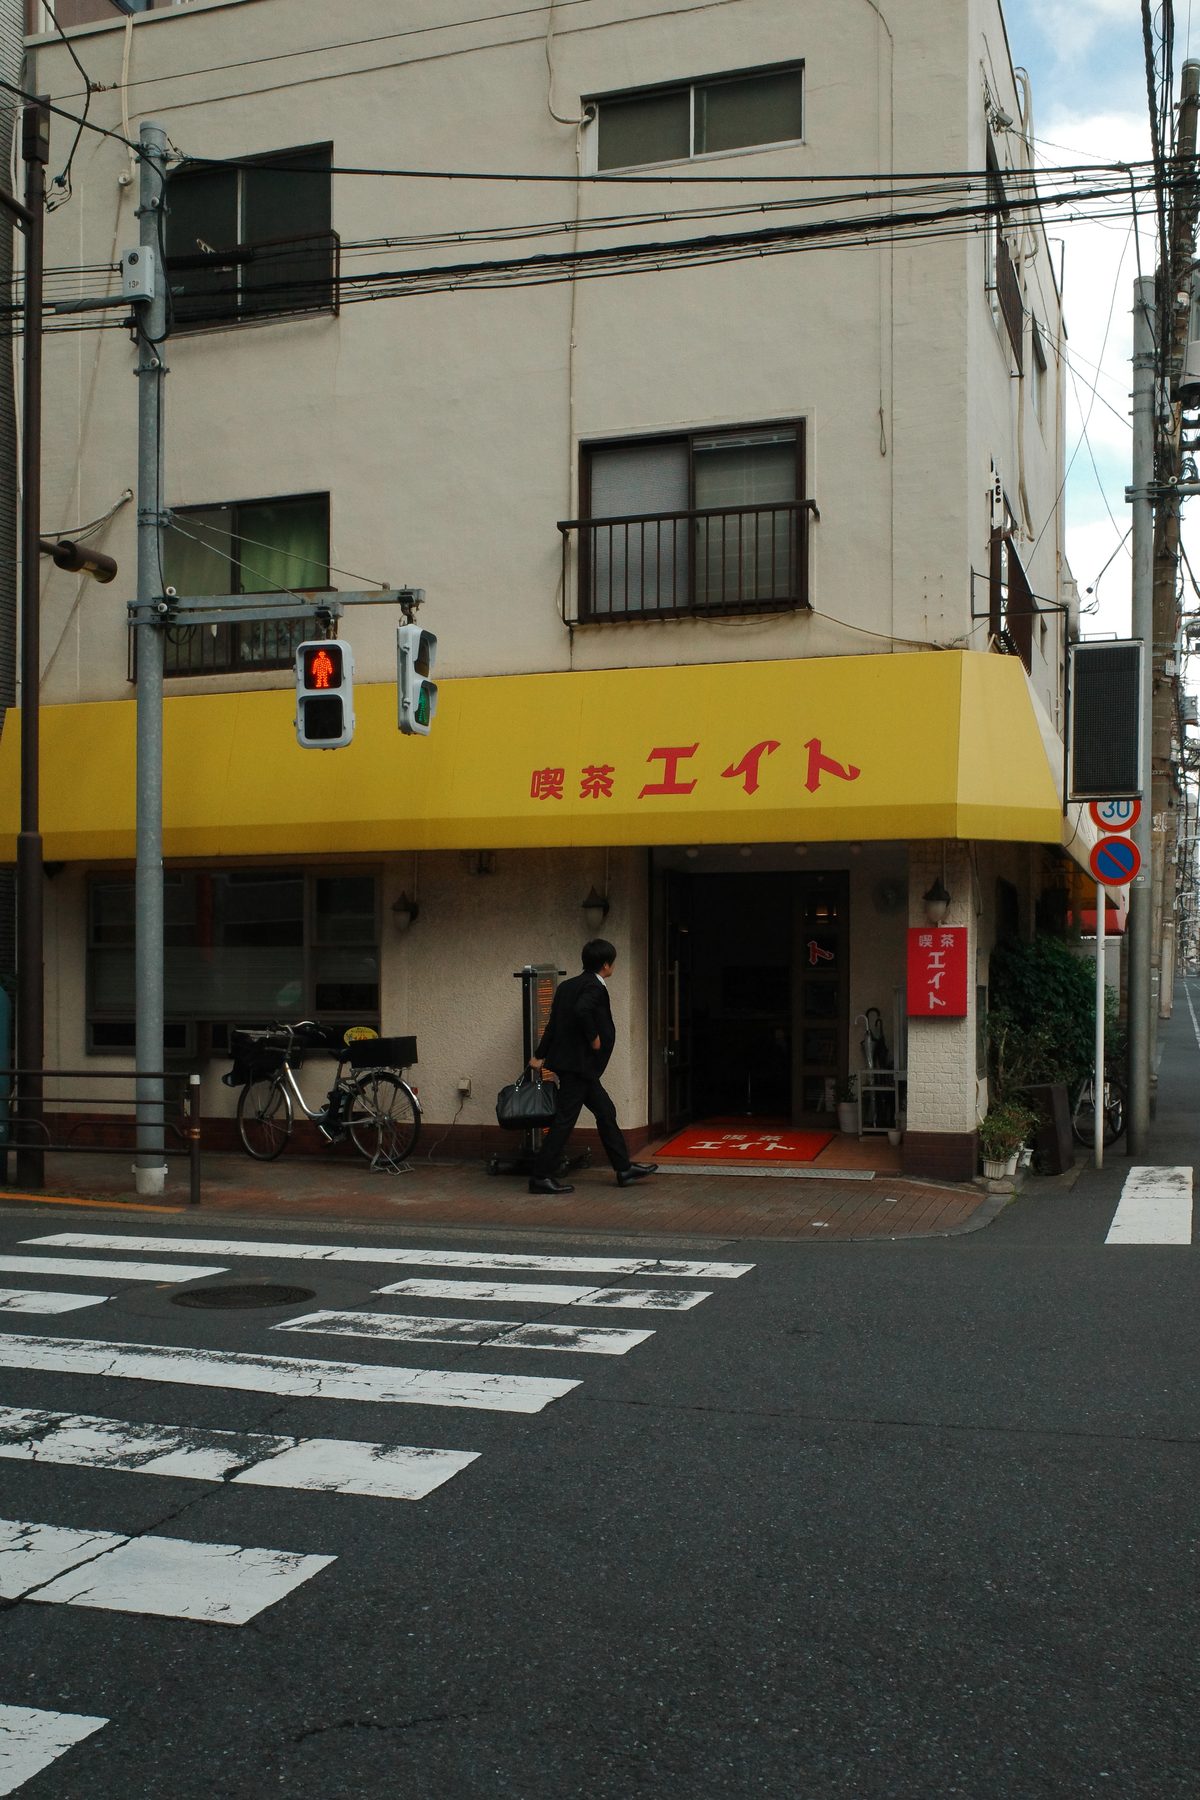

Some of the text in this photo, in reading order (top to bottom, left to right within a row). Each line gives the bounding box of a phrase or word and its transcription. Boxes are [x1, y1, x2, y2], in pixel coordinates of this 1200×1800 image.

[530, 737, 861, 800] 喫茶 エイト
[1102, 800, 1130, 818] 30
[919, 934, 954, 948] 喫茶
[927, 950, 946, 1009] エイト
[687, 1141, 797, 1151] エイト
[722, 1134, 784, 1142] 喫茶
